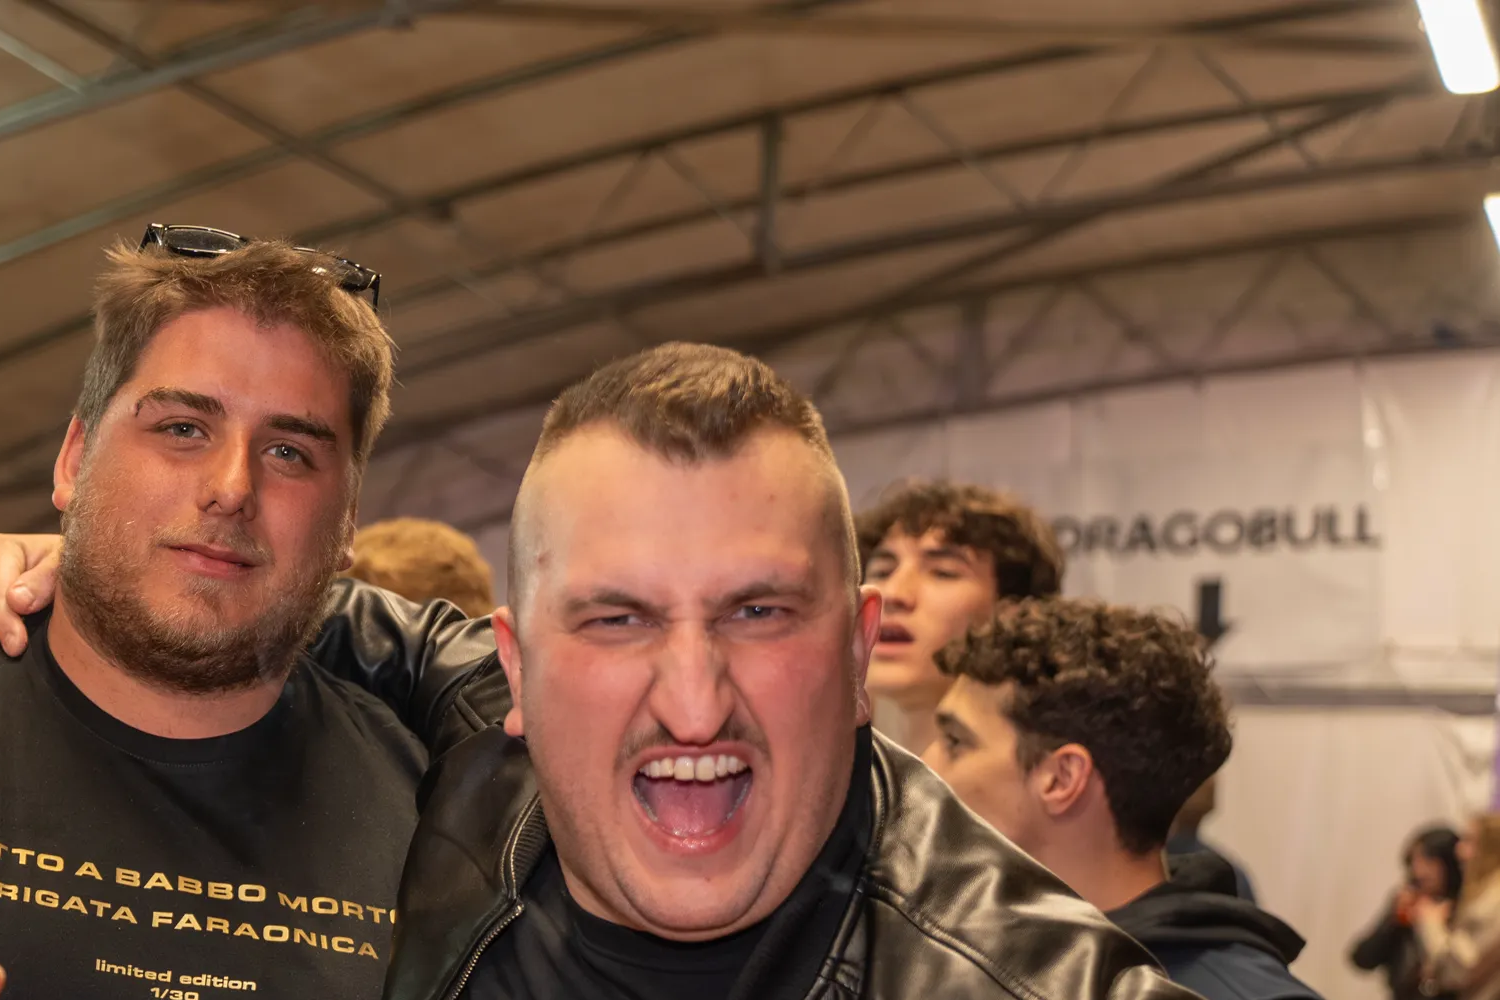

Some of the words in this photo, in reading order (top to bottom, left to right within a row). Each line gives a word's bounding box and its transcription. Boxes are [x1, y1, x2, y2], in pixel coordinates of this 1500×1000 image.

[75, 861, 103, 881] A
[115, 867, 267, 903] BABBO
[151, 911, 379, 960] FARAONICA
[95, 959, 173, 983] limited
[179, 973, 257, 992] edition
